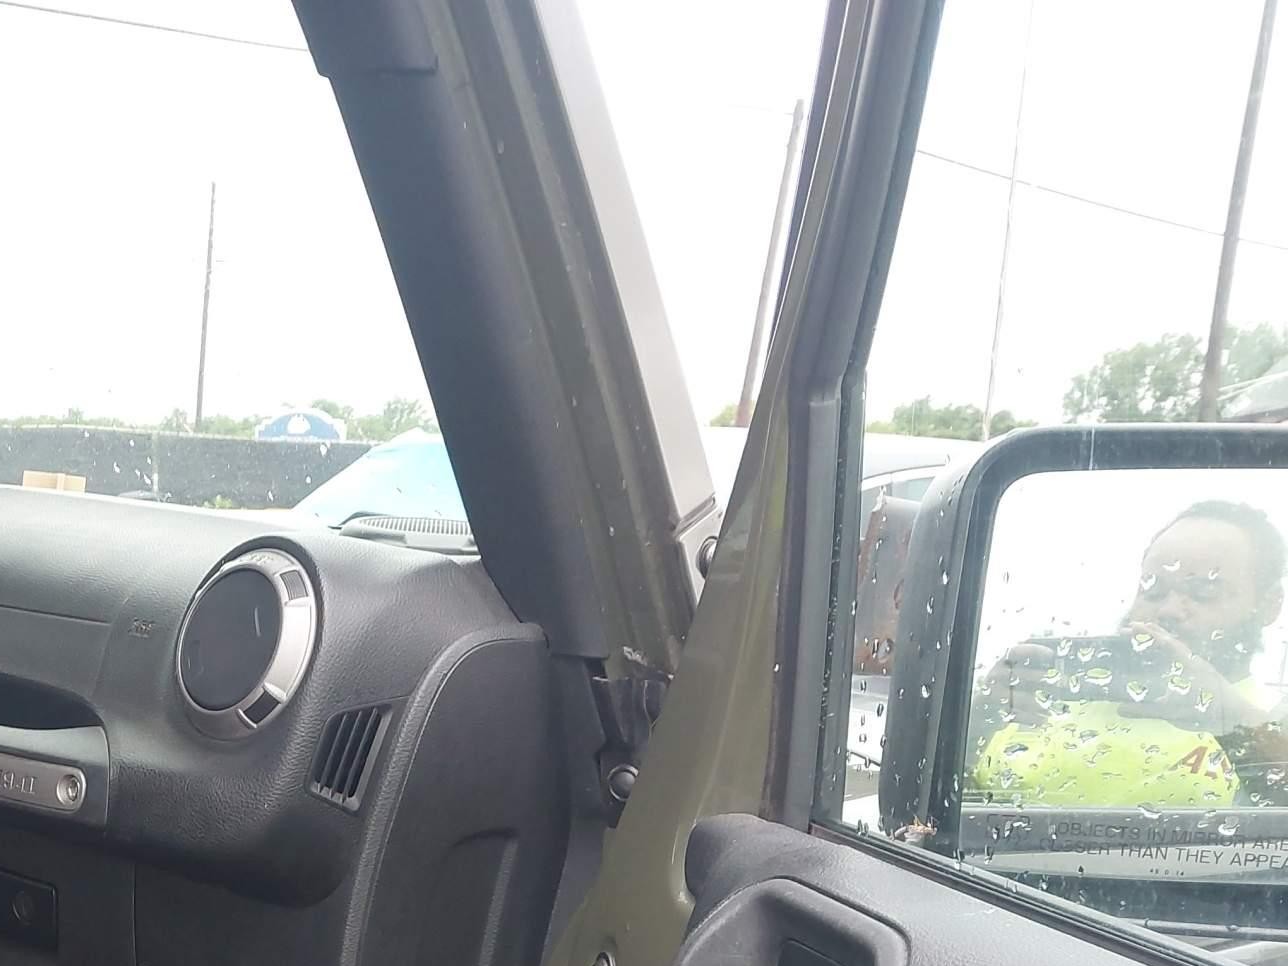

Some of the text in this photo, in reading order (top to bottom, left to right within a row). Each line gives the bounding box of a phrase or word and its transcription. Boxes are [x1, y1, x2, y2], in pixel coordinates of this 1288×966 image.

[1058, 821, 1141, 840] OBJECTS
[1146, 827, 1167, 842] IN
[1170, 829, 1248, 849] MIRROR
[1118, 843, 1169, 861] THAN
[1175, 847, 1225, 865] THEY
